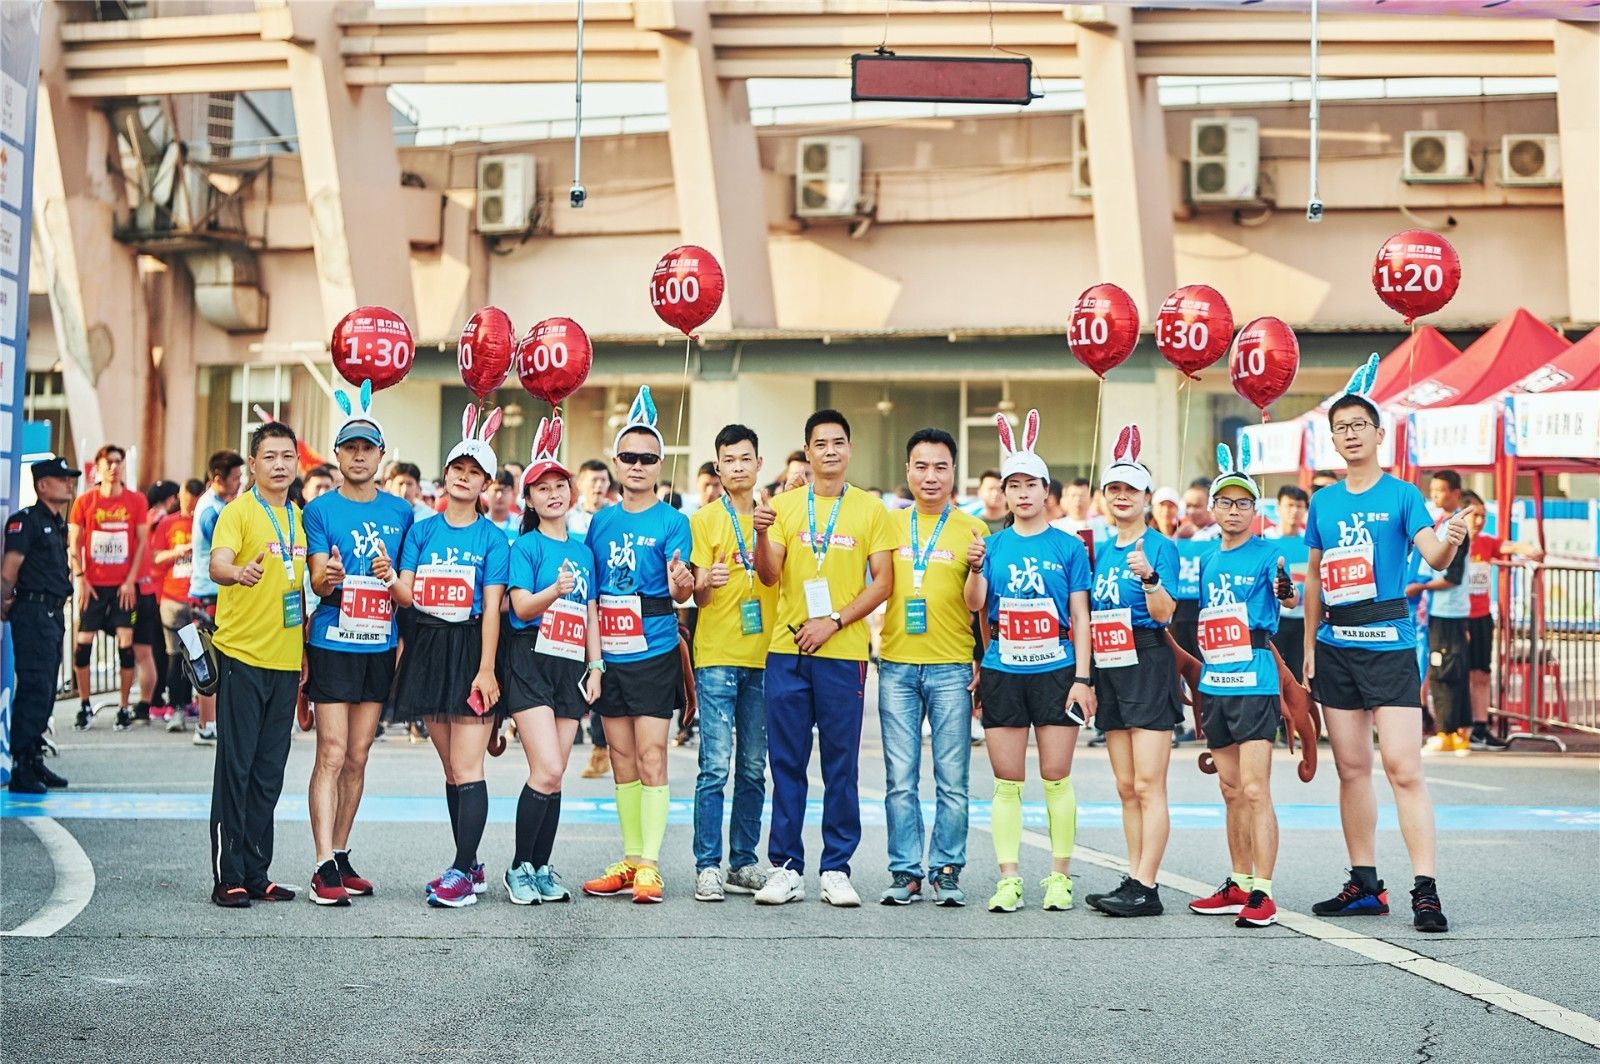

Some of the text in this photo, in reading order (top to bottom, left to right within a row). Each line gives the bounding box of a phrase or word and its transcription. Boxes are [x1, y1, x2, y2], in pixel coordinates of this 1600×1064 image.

[1378, 263, 1444, 292] 1:20
[650, 275, 700, 306] 1:00
[1155, 318, 1209, 352] 1:30
[345, 335, 410, 370] 1:30
[518, 341, 569, 378] 1:00
[1332, 563, 1367, 584] 1:20
[430, 585, 467, 602] 1:20
[361, 596, 392, 615] 1:30
[559, 620, 584, 640] 1:00
[604, 615, 634, 631] 1:00
[1013, 617, 1051, 635] 1:10
[339, 631, 355, 640] WAR
[1097, 628, 1128, 647] 1:30
[1209, 624, 1242, 644] 1:10
[1341, 629, 1387, 638] WAR HORSE
